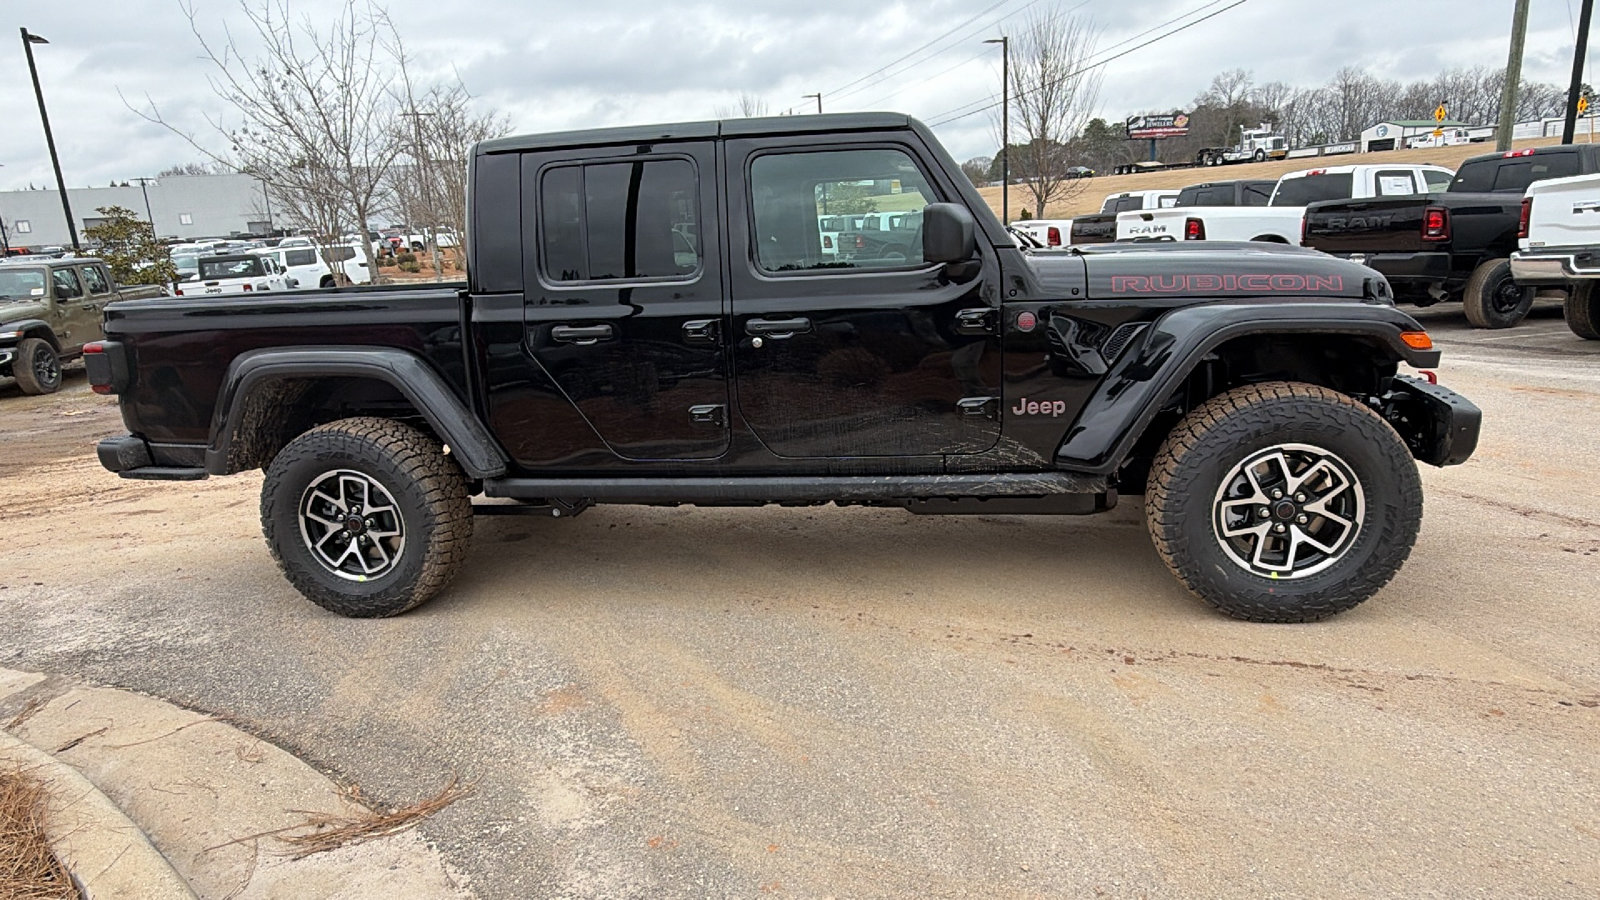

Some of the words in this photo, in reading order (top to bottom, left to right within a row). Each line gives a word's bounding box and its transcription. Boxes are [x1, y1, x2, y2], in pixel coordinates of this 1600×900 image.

[1129, 225, 1167, 234] RAM
[1327, 216, 1392, 229] RAM
[1111, 274, 1344, 292] RUBICON
[1012, 398, 1066, 417] Jeep
